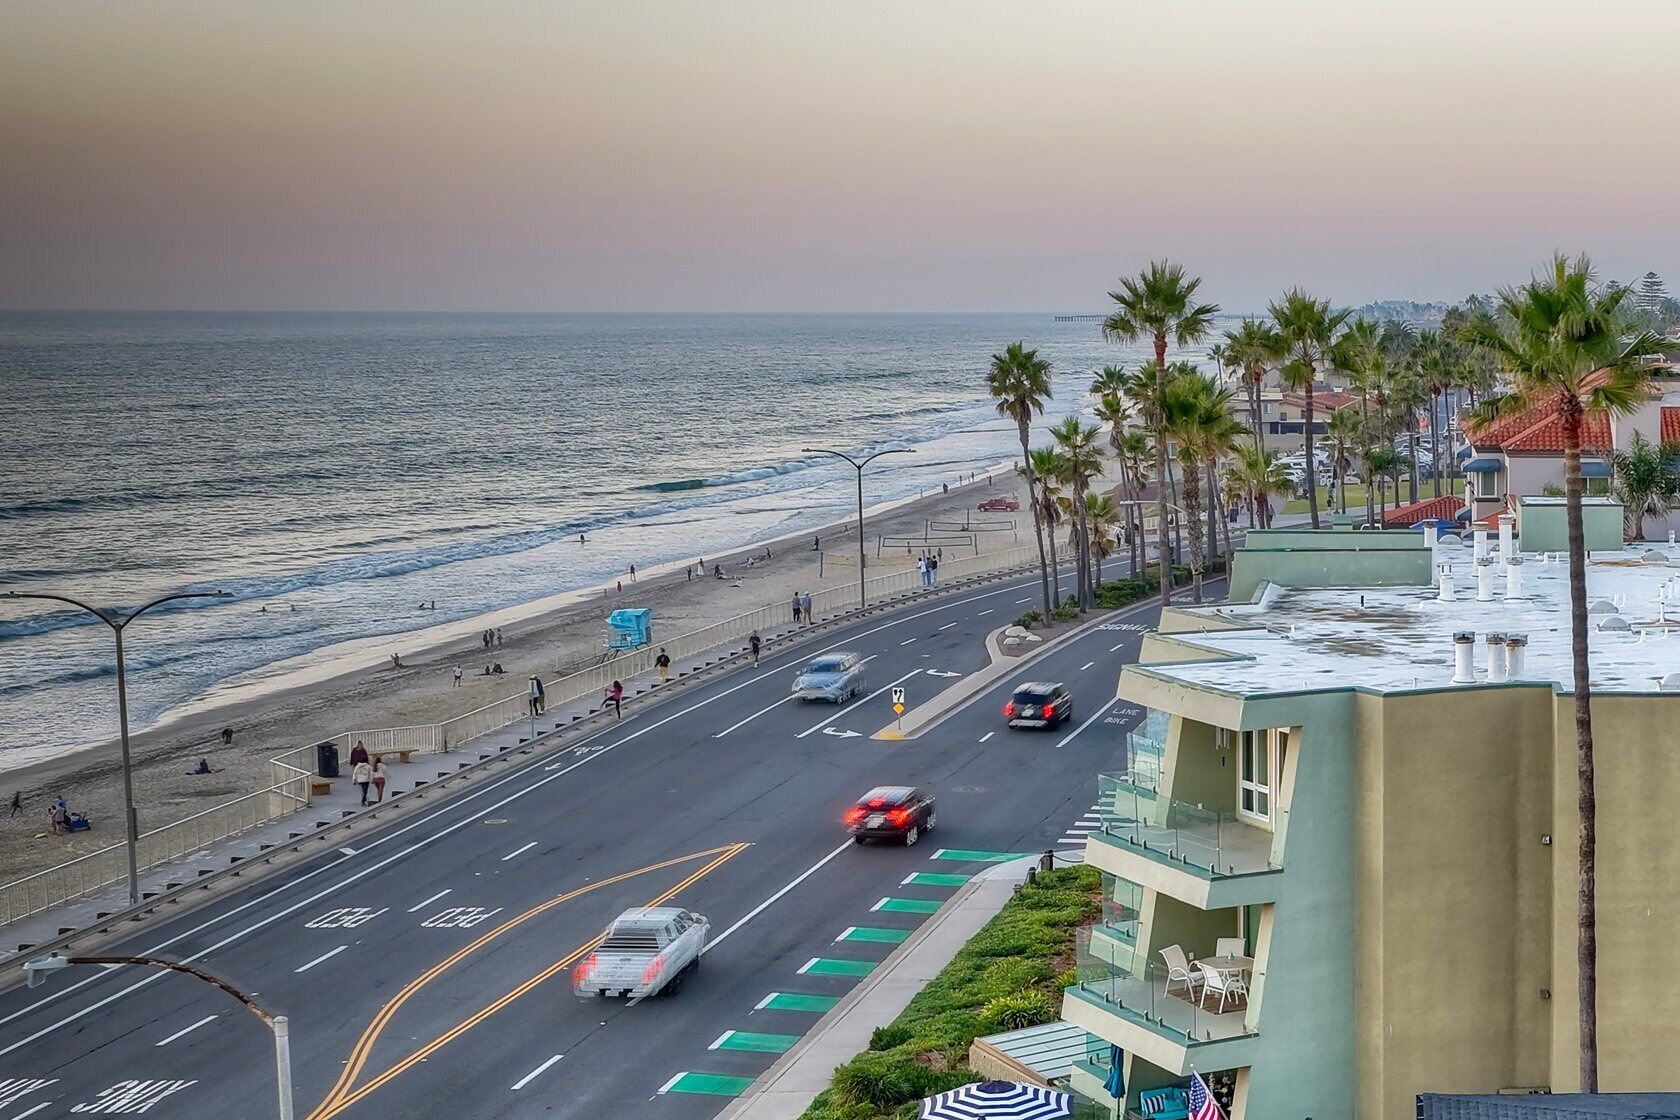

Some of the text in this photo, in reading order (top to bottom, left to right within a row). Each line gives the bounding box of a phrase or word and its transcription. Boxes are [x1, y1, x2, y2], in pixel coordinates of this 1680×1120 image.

[1112, 708, 1140, 716] LANE
[1103, 717, 1129, 725] BIKE
[304, 907, 389, 929] PED
[420, 907, 504, 929] PED
